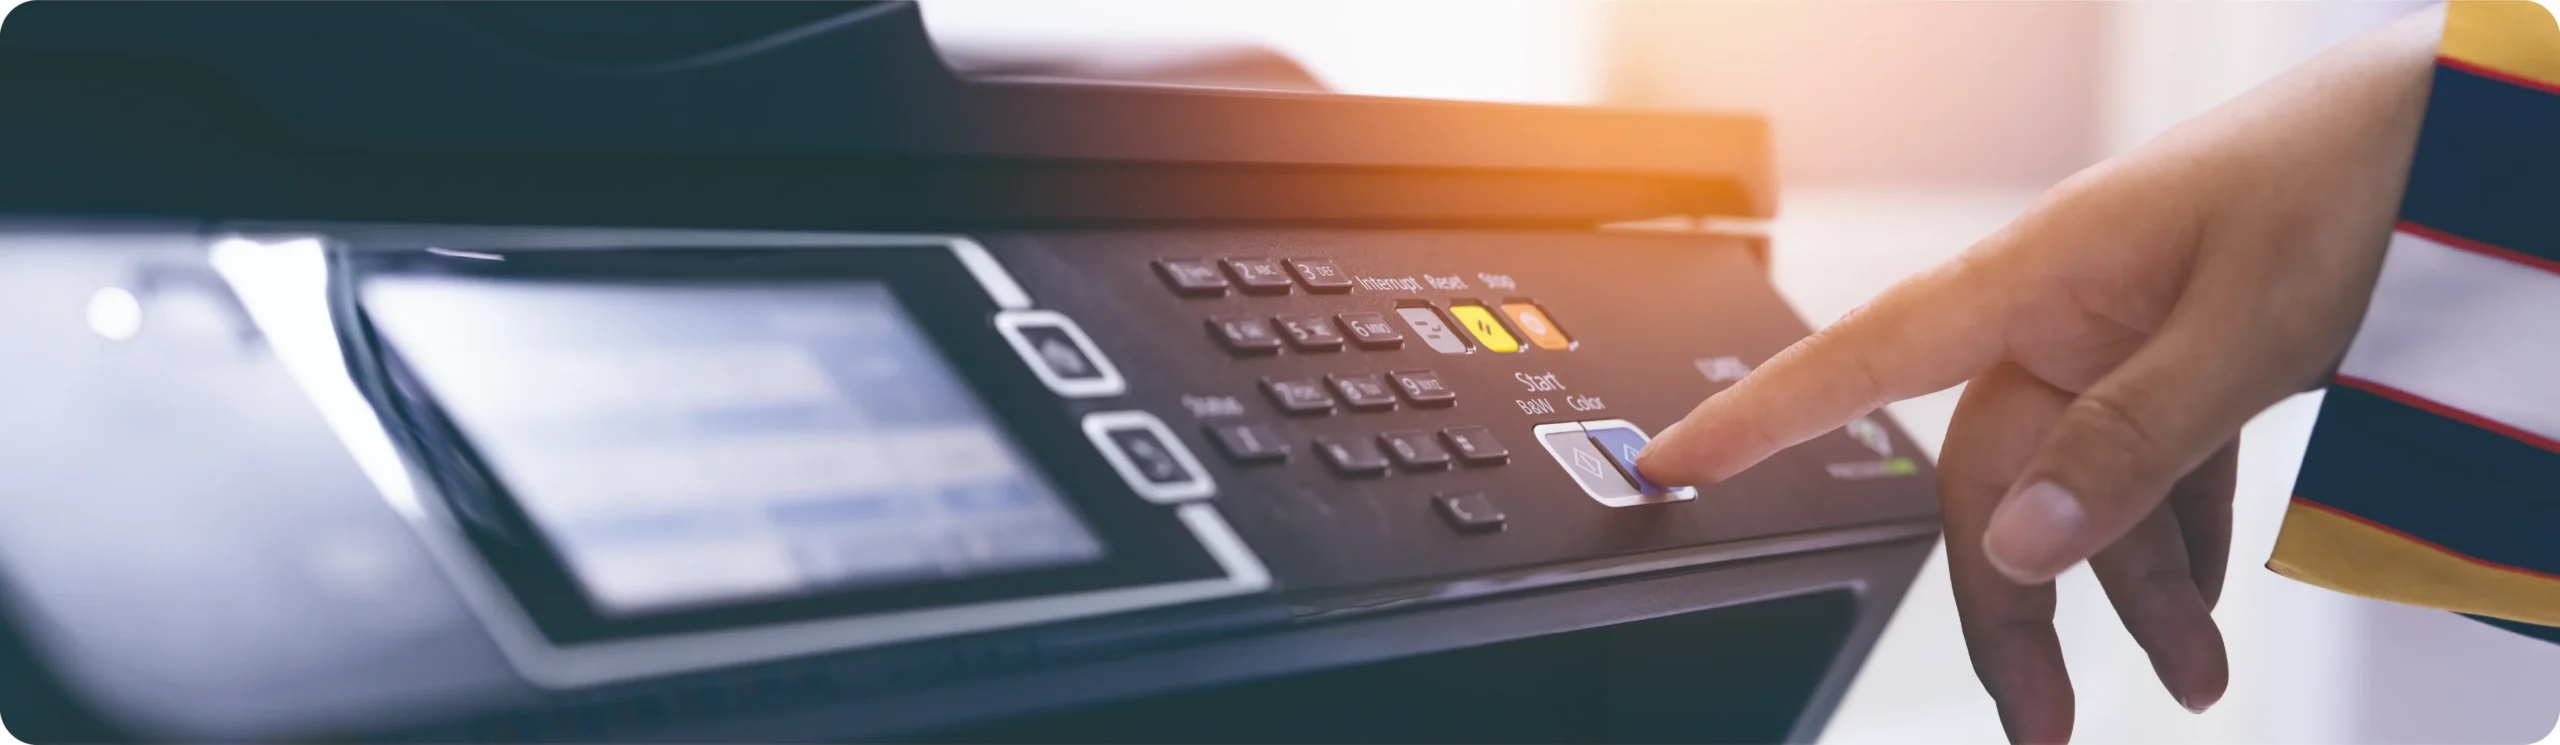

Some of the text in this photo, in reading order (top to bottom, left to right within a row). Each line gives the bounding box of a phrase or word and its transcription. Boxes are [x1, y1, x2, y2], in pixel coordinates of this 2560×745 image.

[1235, 262, 1256, 280] 2
[1298, 264, 1335, 280] 3 DEF
[1354, 275, 1423, 294] Interrupt
[1424, 274, 1469, 290] Reset
[1288, 322, 1308, 340] 5
[1351, 321, 1391, 337] 6 MNO
[1401, 377, 1420, 395] 9
[1515, 372, 1566, 392] Start
[1516, 398, 1555, 415] B&W
[1566, 394, 1605, 412] Color
